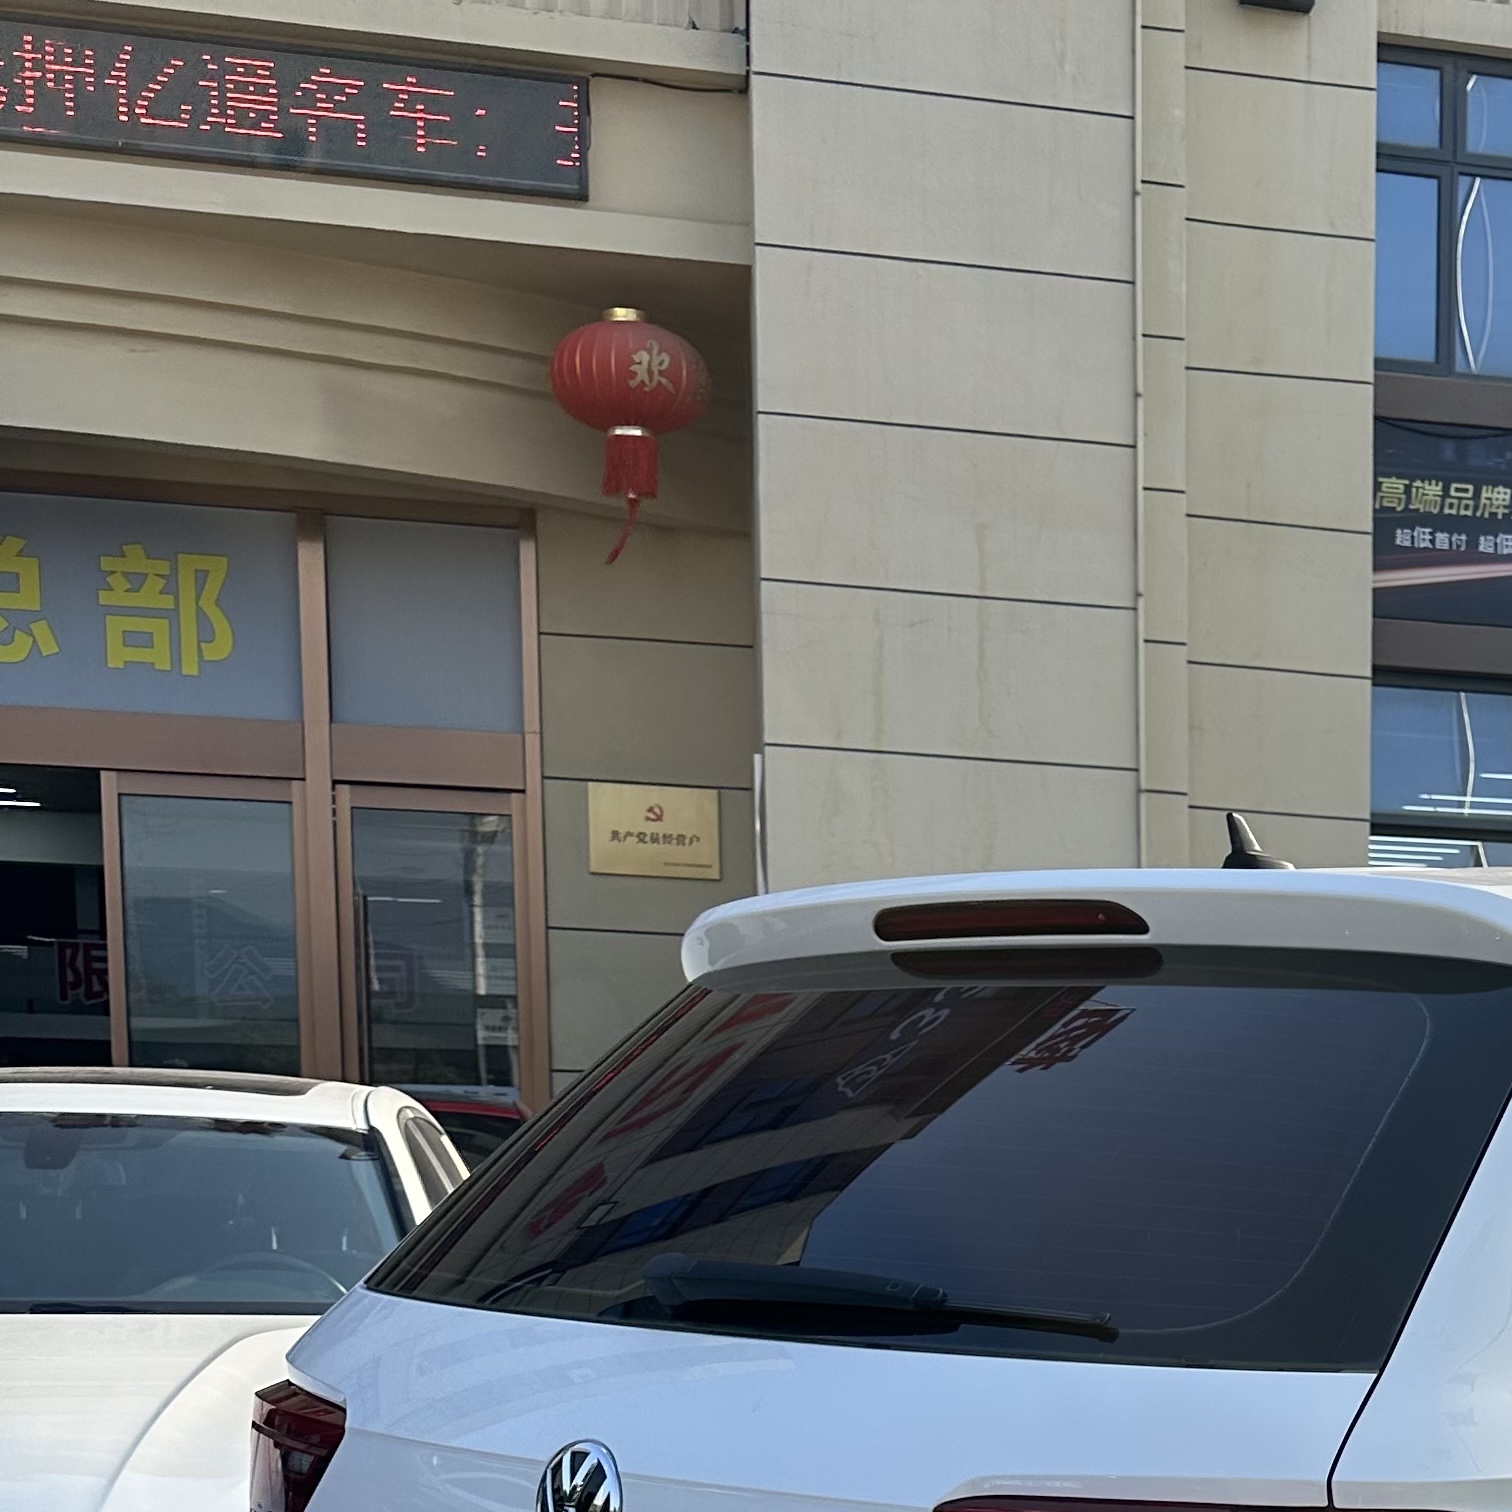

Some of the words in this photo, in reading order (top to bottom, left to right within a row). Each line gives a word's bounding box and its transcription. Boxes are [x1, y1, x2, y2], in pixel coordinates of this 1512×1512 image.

[628, 339, 677, 395] 欢
[1395, 526, 1467, 551] 超低首付
